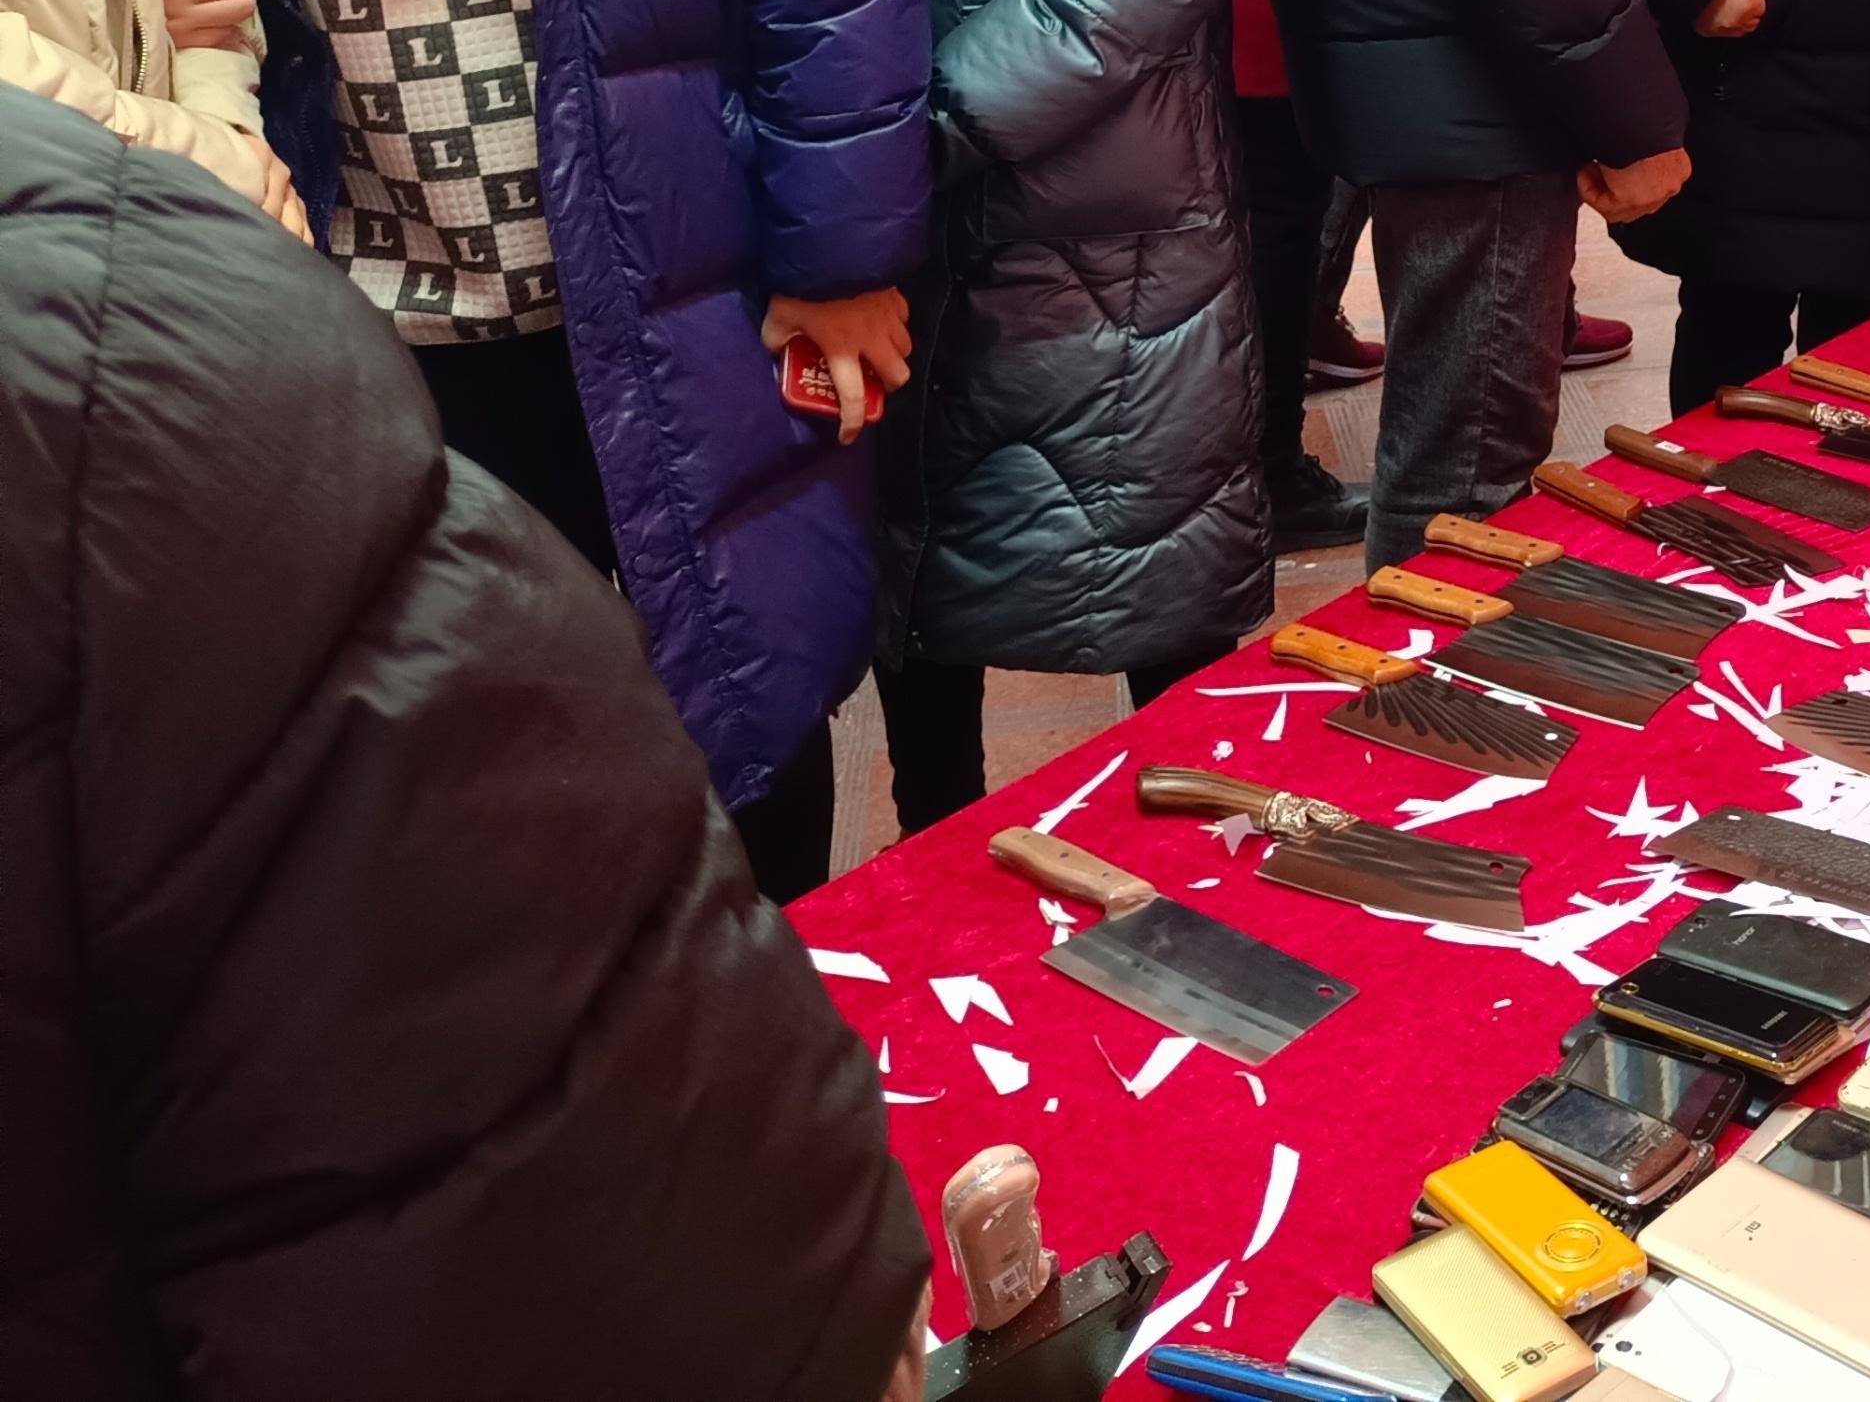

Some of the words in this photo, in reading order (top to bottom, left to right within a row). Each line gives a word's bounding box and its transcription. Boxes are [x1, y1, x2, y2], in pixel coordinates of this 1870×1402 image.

[407, 37, 443, 68] L
[360, 94, 390, 122] L
[483, 79, 516, 111] L
[430, 140, 463, 169] L
[502, 181, 536, 209] L
[368, 221, 394, 248] L
[457, 236, 485, 263] L
[413, 272, 442, 301] L
[523, 276, 556, 301] L
